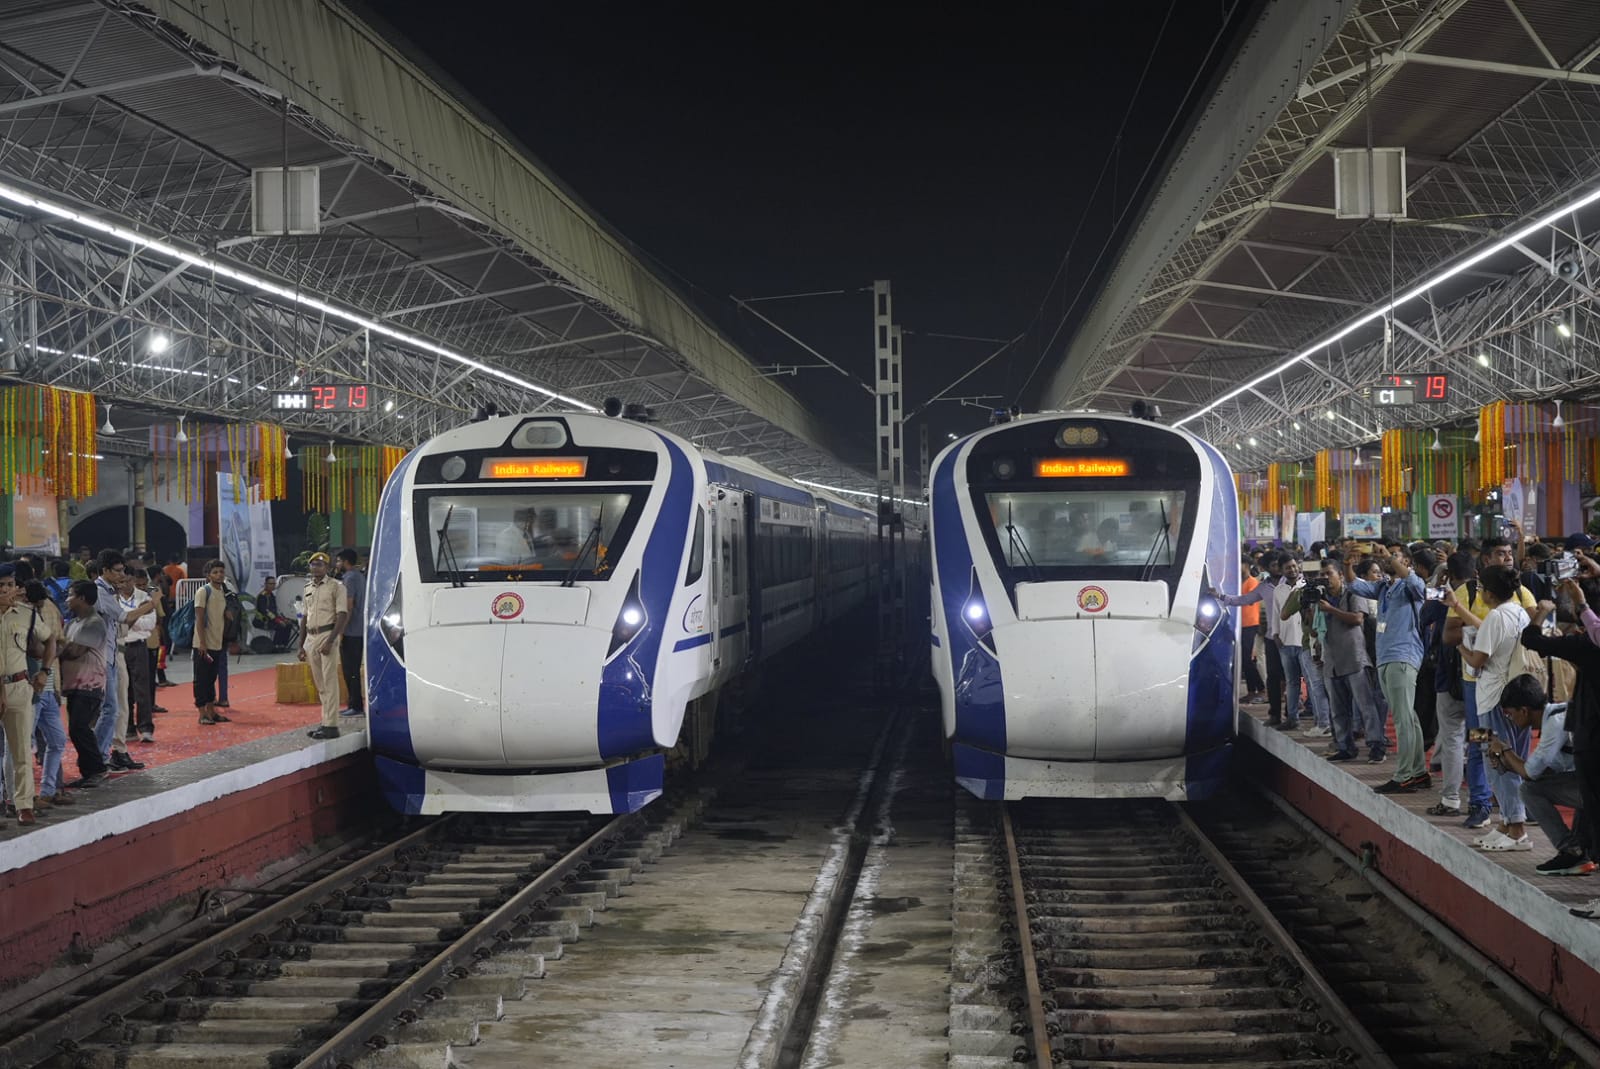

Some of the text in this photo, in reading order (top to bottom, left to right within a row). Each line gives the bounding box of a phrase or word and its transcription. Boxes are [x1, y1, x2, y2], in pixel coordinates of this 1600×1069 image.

[1425, 376, 1446, 398] 19
[278, 394, 307, 409] HWH
[348, 386, 368, 408] 19
[494, 464, 580, 475] Indian Railways
[1041, 463, 1124, 474] Indian Railways
